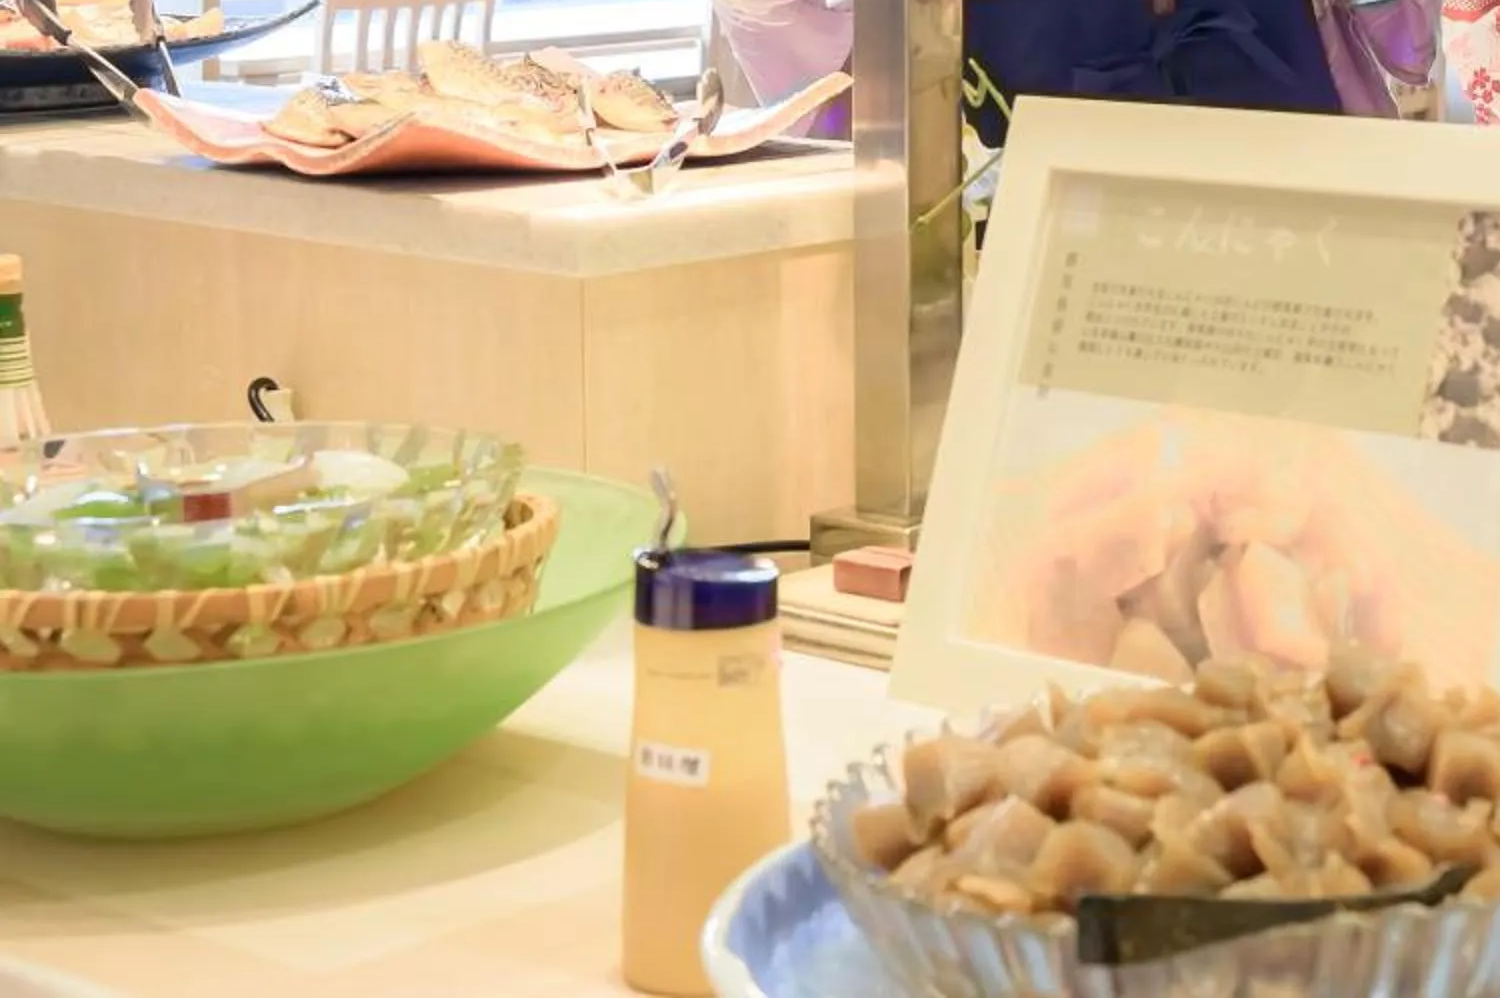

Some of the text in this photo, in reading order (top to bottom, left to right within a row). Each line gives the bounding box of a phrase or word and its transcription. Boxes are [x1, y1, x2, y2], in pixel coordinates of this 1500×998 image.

[1136, 205, 1342, 267] こんにゃく
